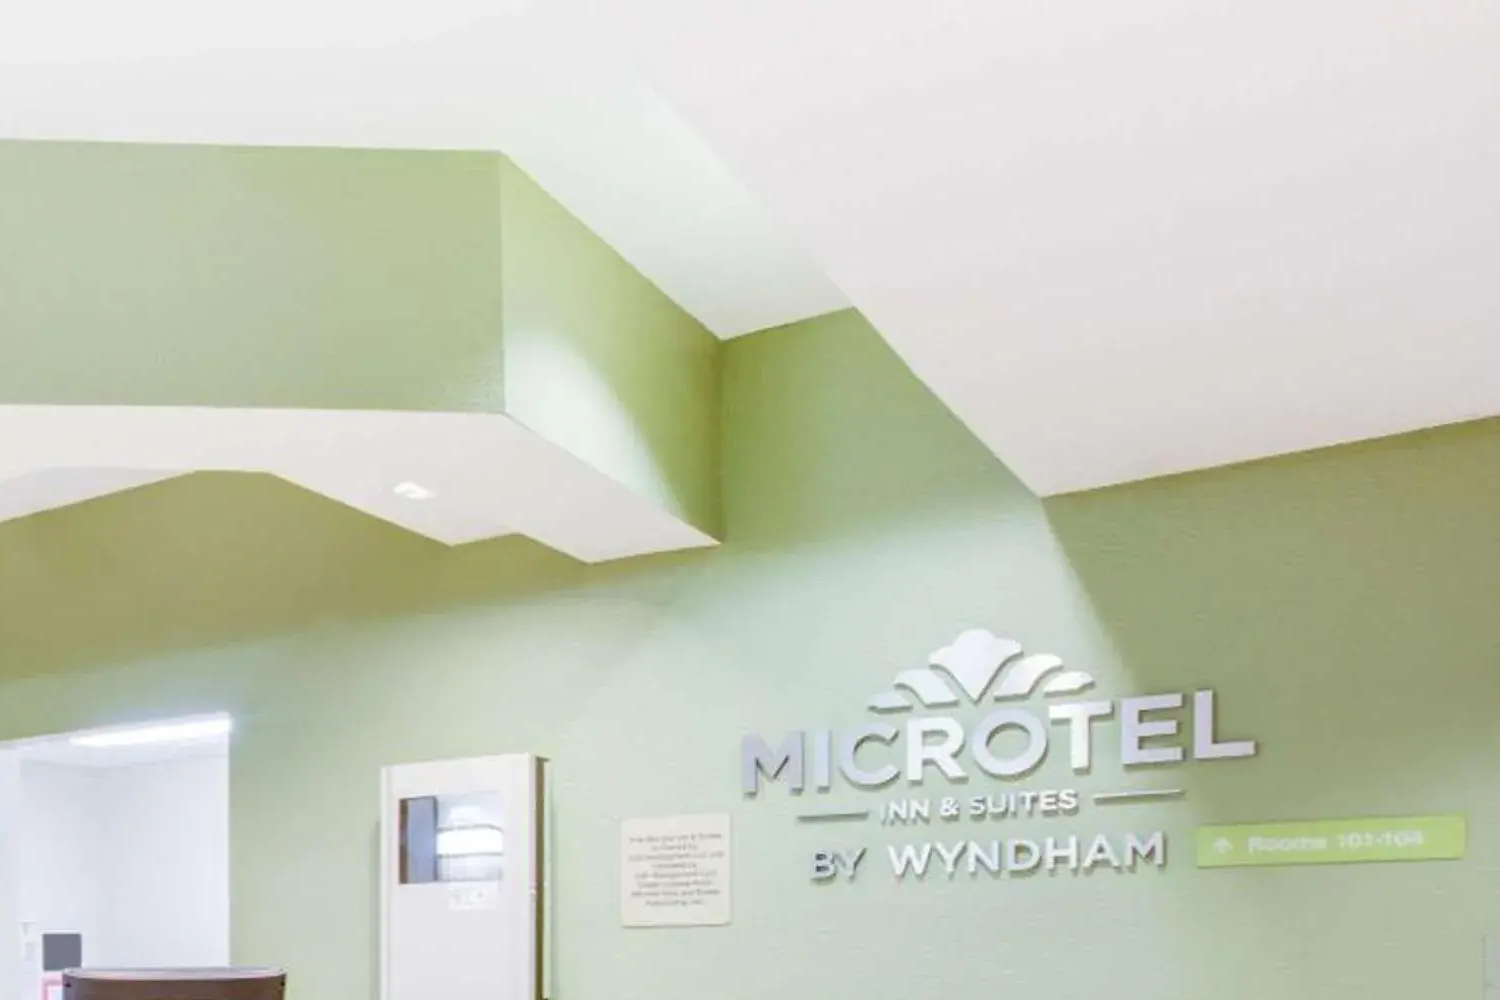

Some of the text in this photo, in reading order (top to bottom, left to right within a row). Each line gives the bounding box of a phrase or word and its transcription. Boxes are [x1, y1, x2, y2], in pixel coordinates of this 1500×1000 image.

[741, 690, 1257, 798] MICROTEL
[880, 788, 1079, 825] INN & SUITES
[811, 830, 1168, 886] BY WYNDHAM
[1248, 835, 1327, 854] Rooms
